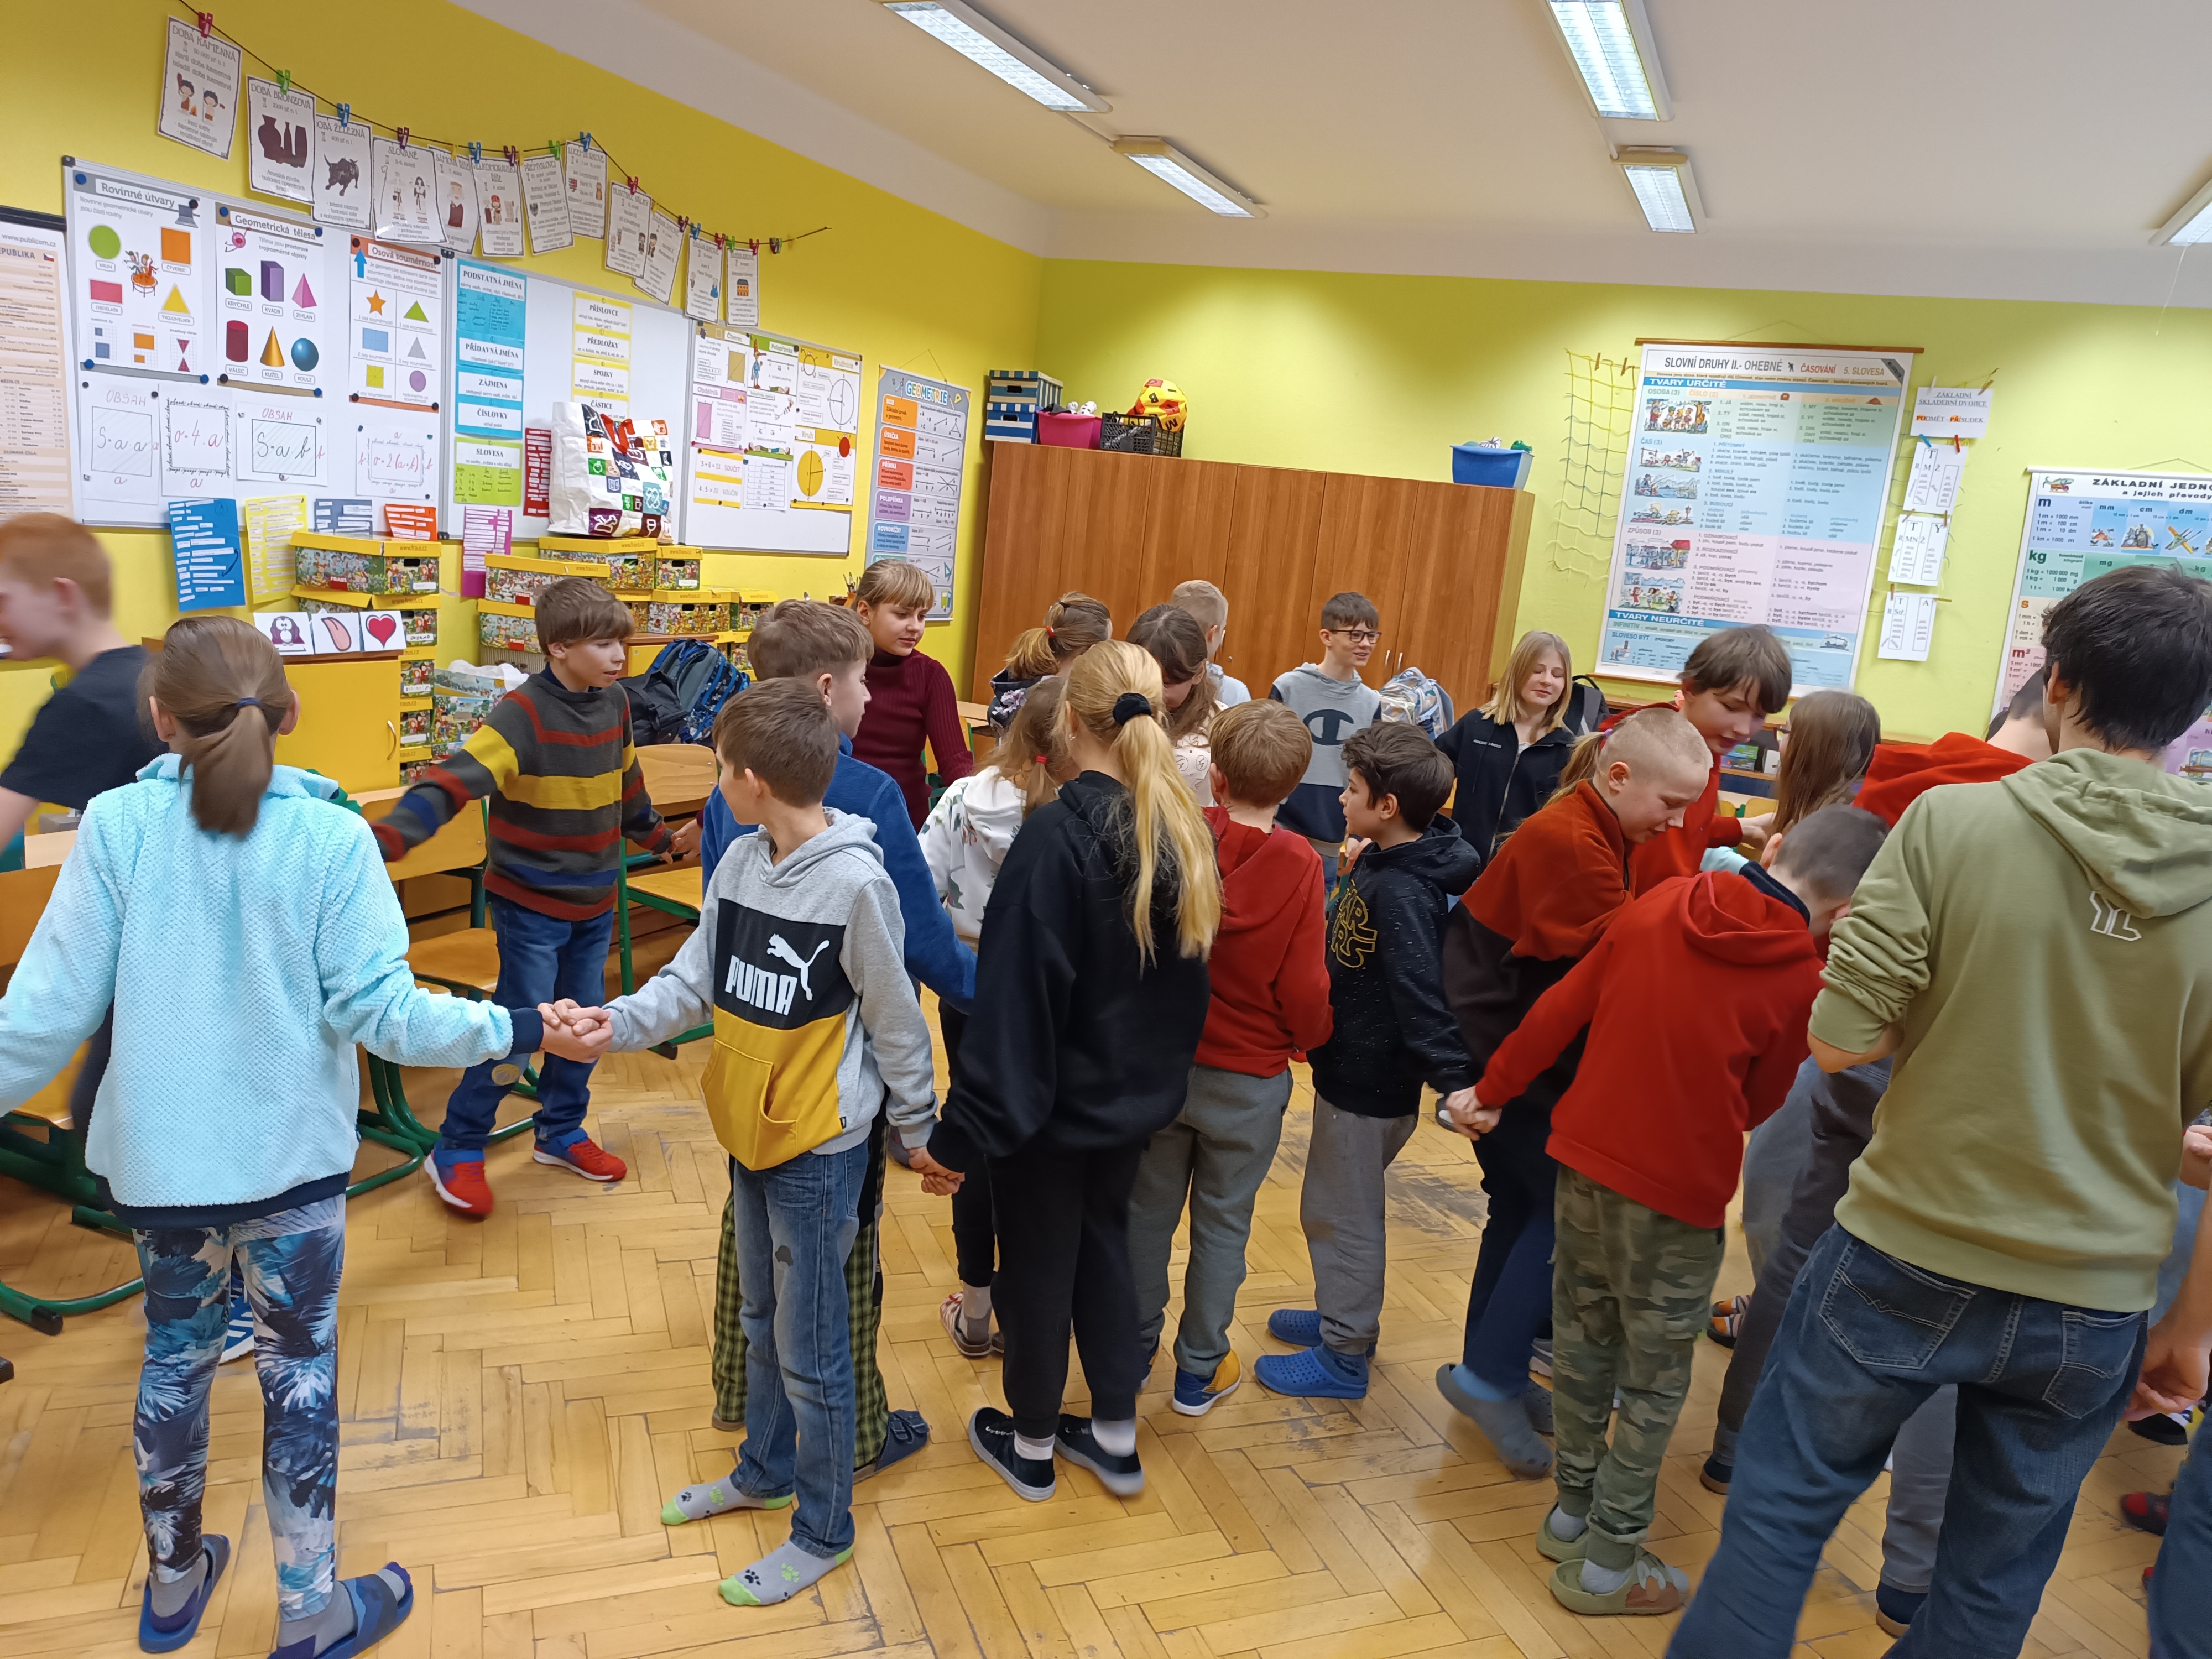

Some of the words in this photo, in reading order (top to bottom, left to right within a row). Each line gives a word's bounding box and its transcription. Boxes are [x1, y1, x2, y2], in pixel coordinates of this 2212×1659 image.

[173, 25, 194, 43] DOBA
[197, 36, 236, 62] KAMENNÁ
[251, 83, 271, 97] DOBA
[273, 91, 311, 109] BRONZOVÁ
[334, 123, 365, 138] ŽELEZNÁ
[101, 182, 142, 200] Rovinné
[145, 193, 175, 208] útvary
[80, 196, 102, 206] Rovinné
[103, 202, 137, 213] geometrické
[235, 215, 290, 234] Geometrická
[294, 227, 316, 241] tělesa
[2, 233, 56, 247] www.publicom.cz
[259, 237, 273, 245] Tělesa
[285, 242, 309, 252] prostorové
[259, 245, 290, 256] trojrozměrné
[291, 251, 307, 260] objekty
[372, 247, 394, 259] Osová
[395, 253, 436, 269] souměrnost
[166, 264, 186, 273] ČTVEREC
[463, 270, 501, 285] PODSTATNÁ
[503, 280, 522, 290] JMÉNA
[227, 301, 250, 309] KRYCHLE
[589, 304, 619, 316] PŘÍSLOVCE
[410, 325, 433, 333] souměrnosti
[587, 337, 618, 348] PŘEDLOŽKY
[727, 332, 743, 342] Čtverec
[466, 343, 498, 355] PŘÍDAVNÁ
[499, 349, 518, 358] JMÉNA
[771, 343, 793, 354] Polopřímka
[834, 358, 853, 369] Kružnice
[1665, 356, 1697, 368] SLOVNÍ
[1699, 359, 1730, 369] DRUHY
[1744, 359, 1783, 372] OHEBNÉ
[1801, 363, 1837, 374] ČASOVÁNÍ
[593, 369, 613, 378] SPOJKY
[1852, 367, 1884, 376] SLOVESA
[479, 378, 507, 389] ZÁJMENA
[697, 387, 718, 395] Obdélník
[906, 381, 948, 404] GEOMETRIE
[107, 390, 146, 406] OBSAH
[591, 400, 613, 409] ČÁSTICE
[262, 408, 293, 421] OBSAH
[477, 408, 508, 419] ČÍSLOVKY
[802, 430, 813, 440] Kruh
[884, 431, 899, 440] ÚSEČKA
[476, 448, 503, 457] SLOVESA
[1928, 450, 1936, 459] T
[724, 463, 740, 473] SOUČET
[2092, 478, 2163, 488] ZÁKLADNÍ
[880, 495, 903, 504] POLOPŘÍMKA
[2038, 498, 2051, 507] m
[1911, 523, 1918, 531] T
[1936, 524, 1943, 533] Y
[2029, 550, 2047, 564] kg
[2021, 600, 2029, 608] s
[1616, 612, 1648, 620] TVARY
[1651, 615, 1704, 627] NEURČITÉ
[724, 955, 797, 1016] PUMA
